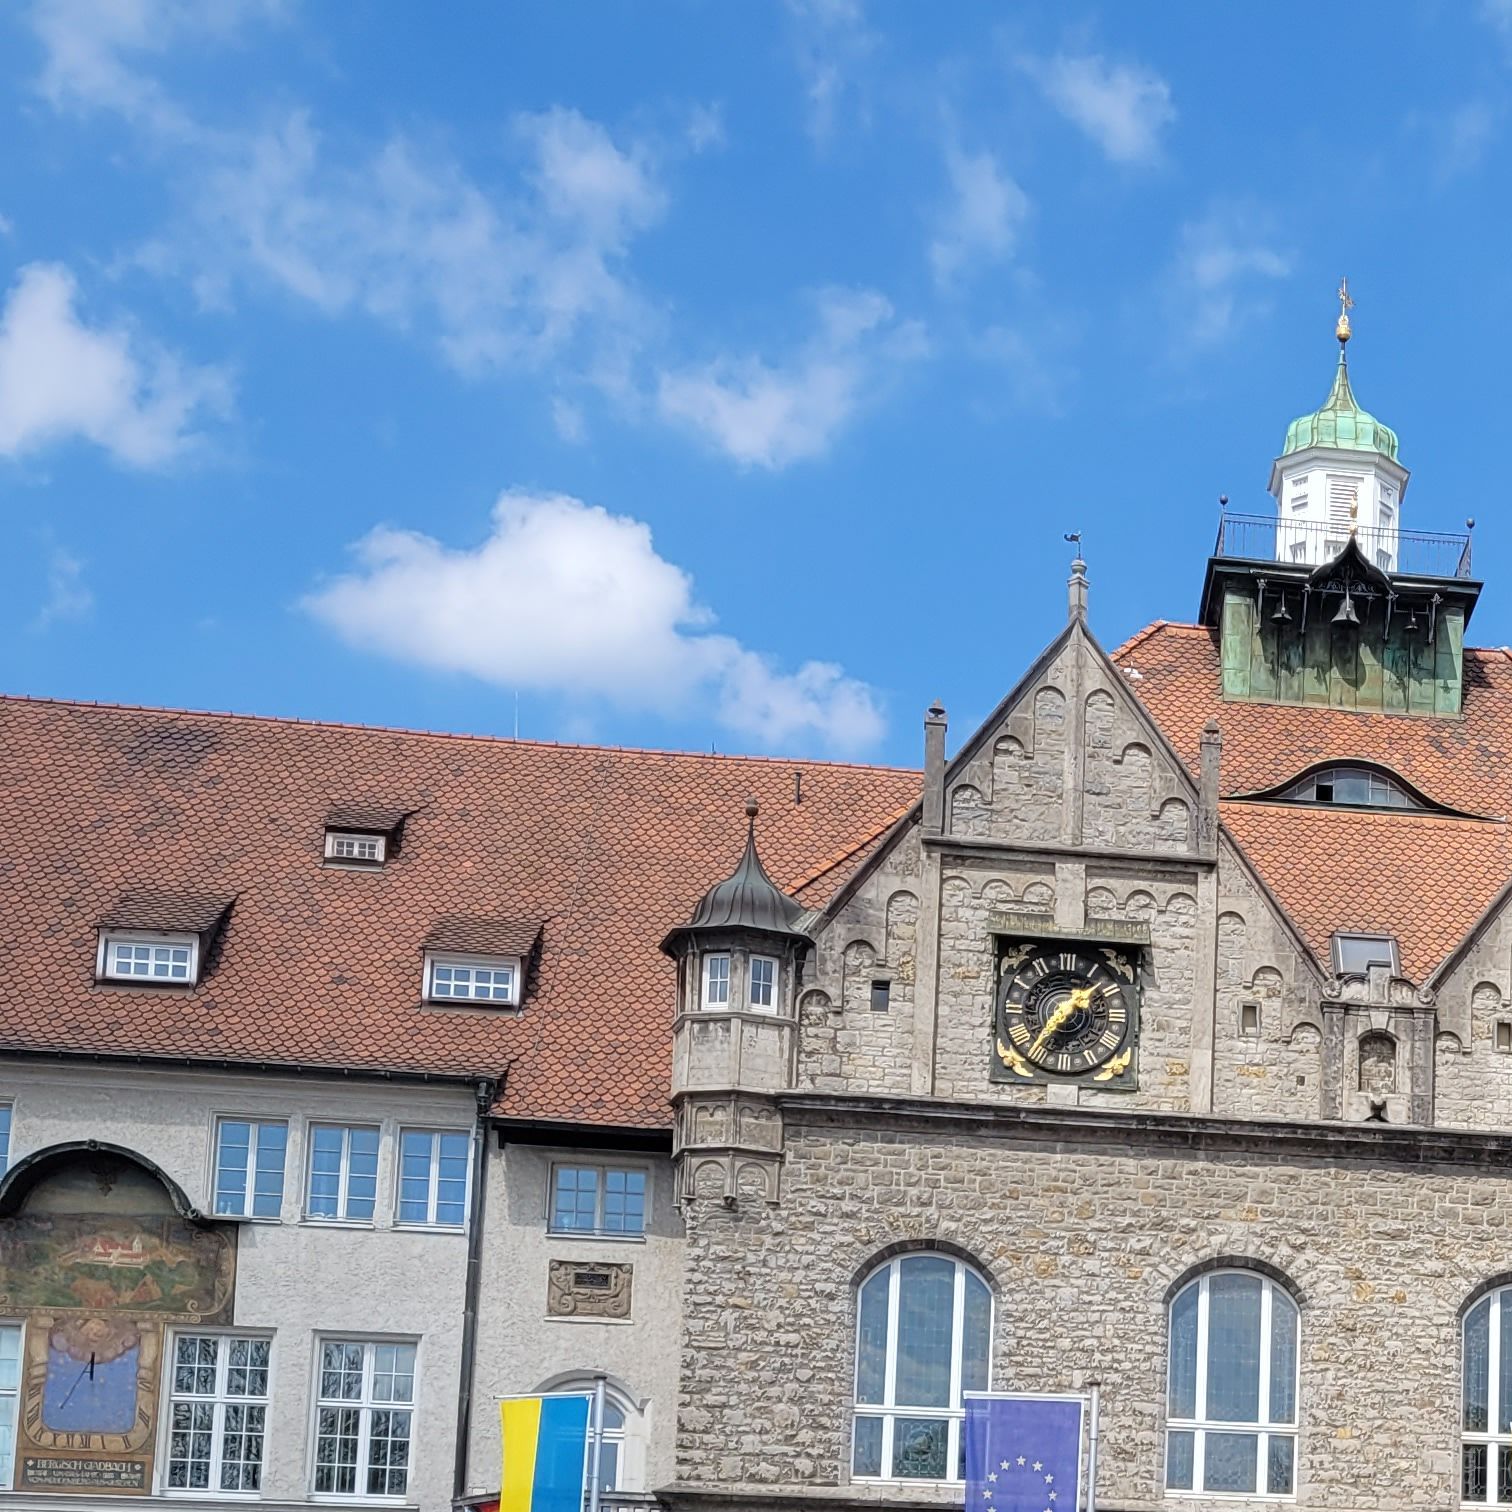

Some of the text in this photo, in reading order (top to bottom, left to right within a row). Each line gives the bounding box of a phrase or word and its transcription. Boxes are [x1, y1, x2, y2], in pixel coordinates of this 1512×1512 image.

[1032, 957, 1049, 977] XI
[1059, 953, 1077, 971] XII
[1086, 963, 1099, 978] I
[1102, 983, 1120, 997] II
[1005, 1000, 1023, 1014] IX
[1108, 1008, 1126, 1022] III
[1008, 1022, 1031, 1046] VIII
[1057, 1053, 1071, 1071] VI
